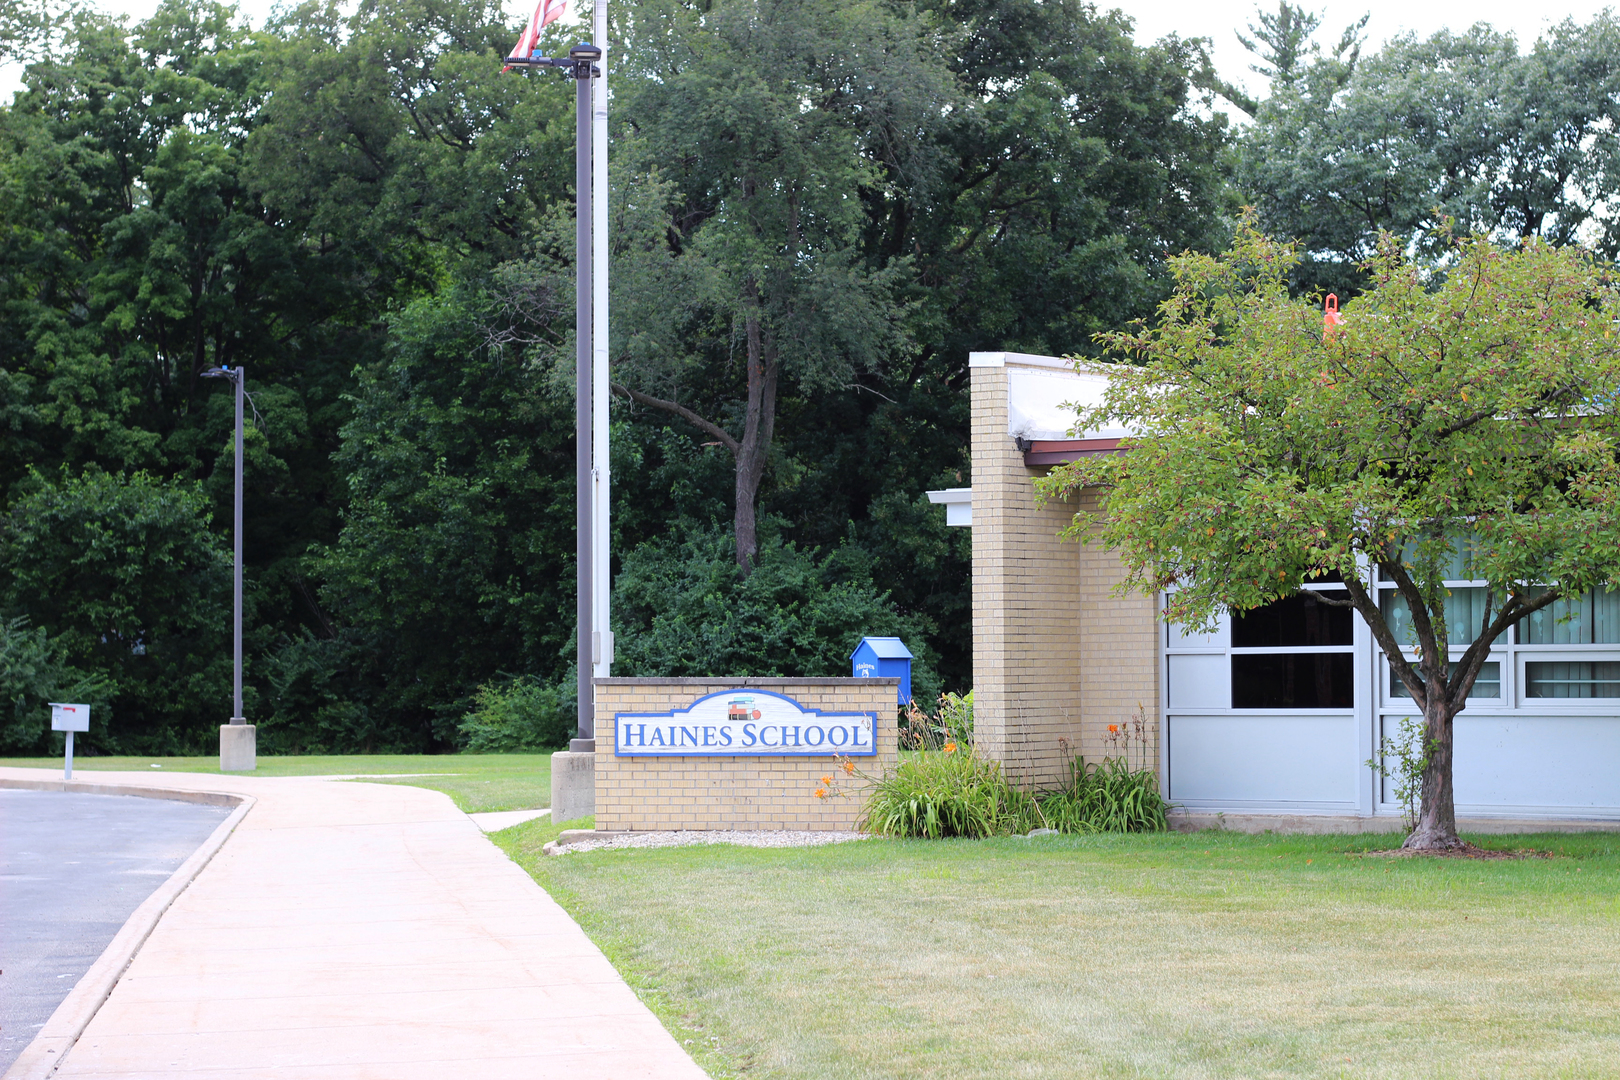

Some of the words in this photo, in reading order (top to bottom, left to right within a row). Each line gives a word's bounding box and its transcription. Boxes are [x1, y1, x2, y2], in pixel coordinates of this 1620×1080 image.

[856, 662, 875, 671] Haines
[623, 723, 733, 747] HAINES
[741, 723, 868, 747] SCHOOL
